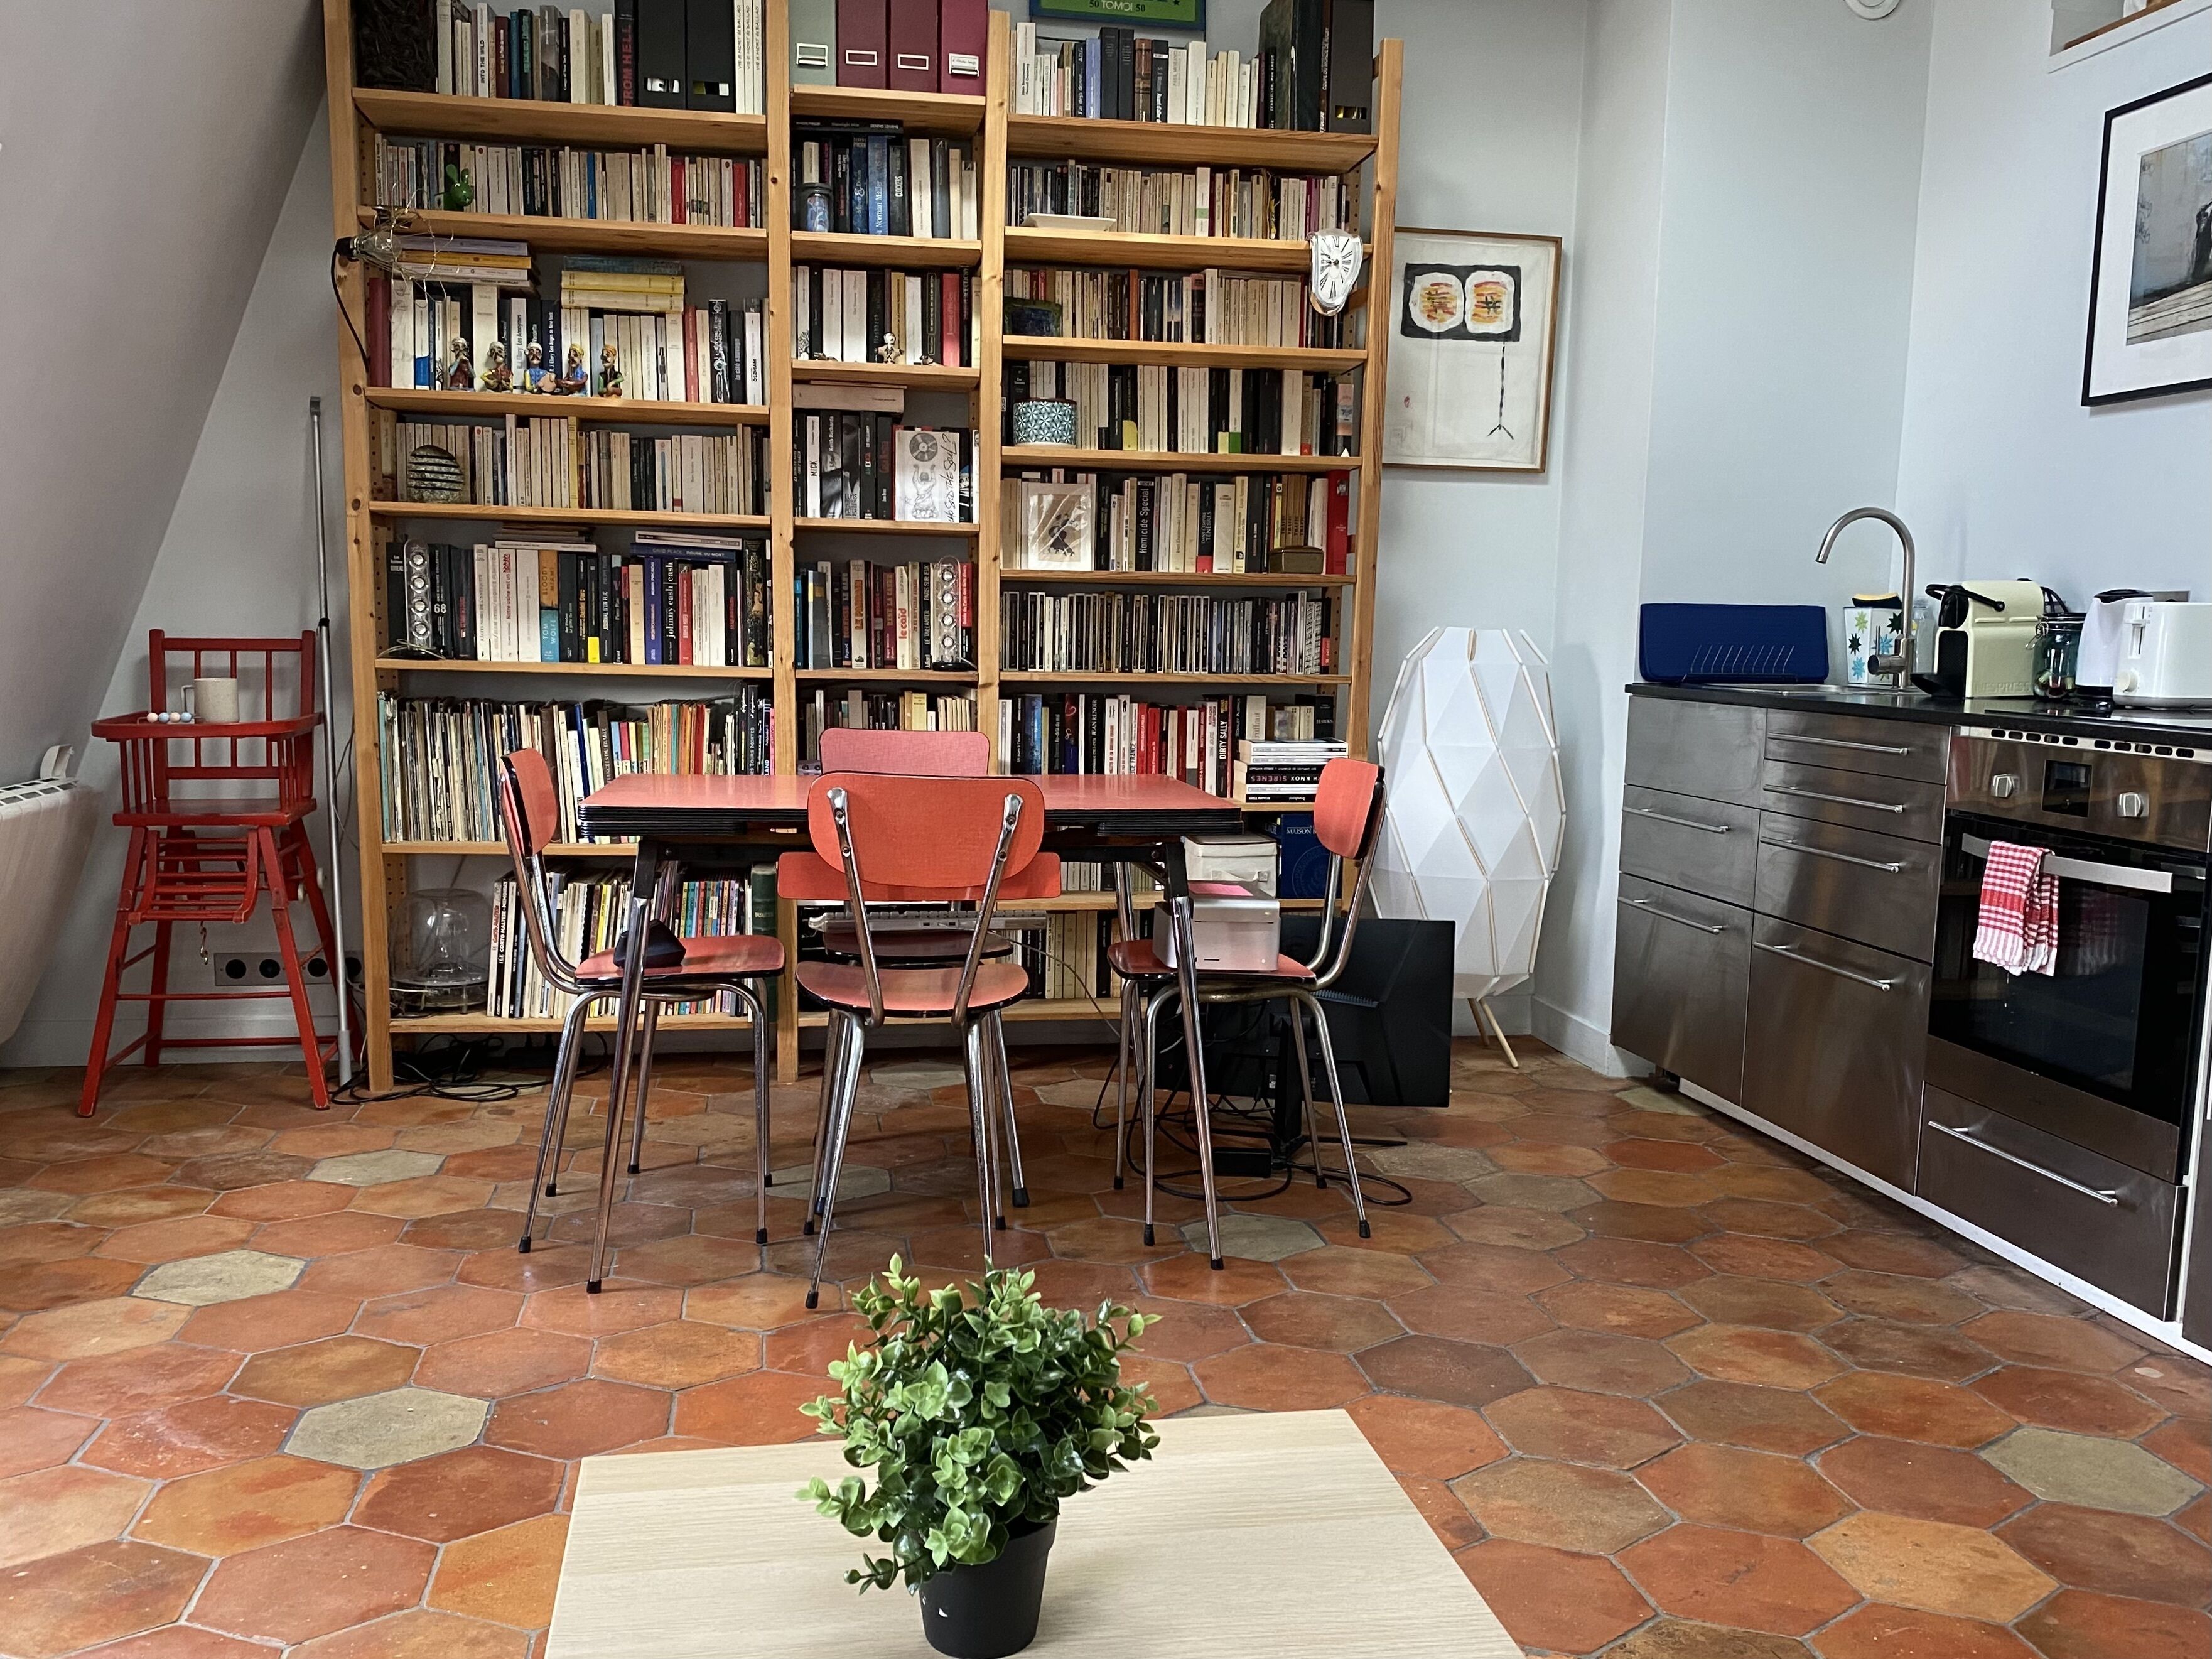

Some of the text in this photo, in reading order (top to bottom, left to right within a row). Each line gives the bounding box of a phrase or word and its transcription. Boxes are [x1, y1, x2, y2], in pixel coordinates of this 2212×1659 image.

[1089, 0, 1099, 8] 50
[1135, 4, 1146, 13] 50
[622, 24, 633, 107] FROM HELL
[939, 472, 954, 489] THE
[1138, 488, 1150, 553] Homicide Special
[665, 561, 676, 639] johnny cash cash
[898, 608, 907, 639] le caïd
[1219, 720, 1227, 739] SALLY
[603, 747, 609, 756] DU
